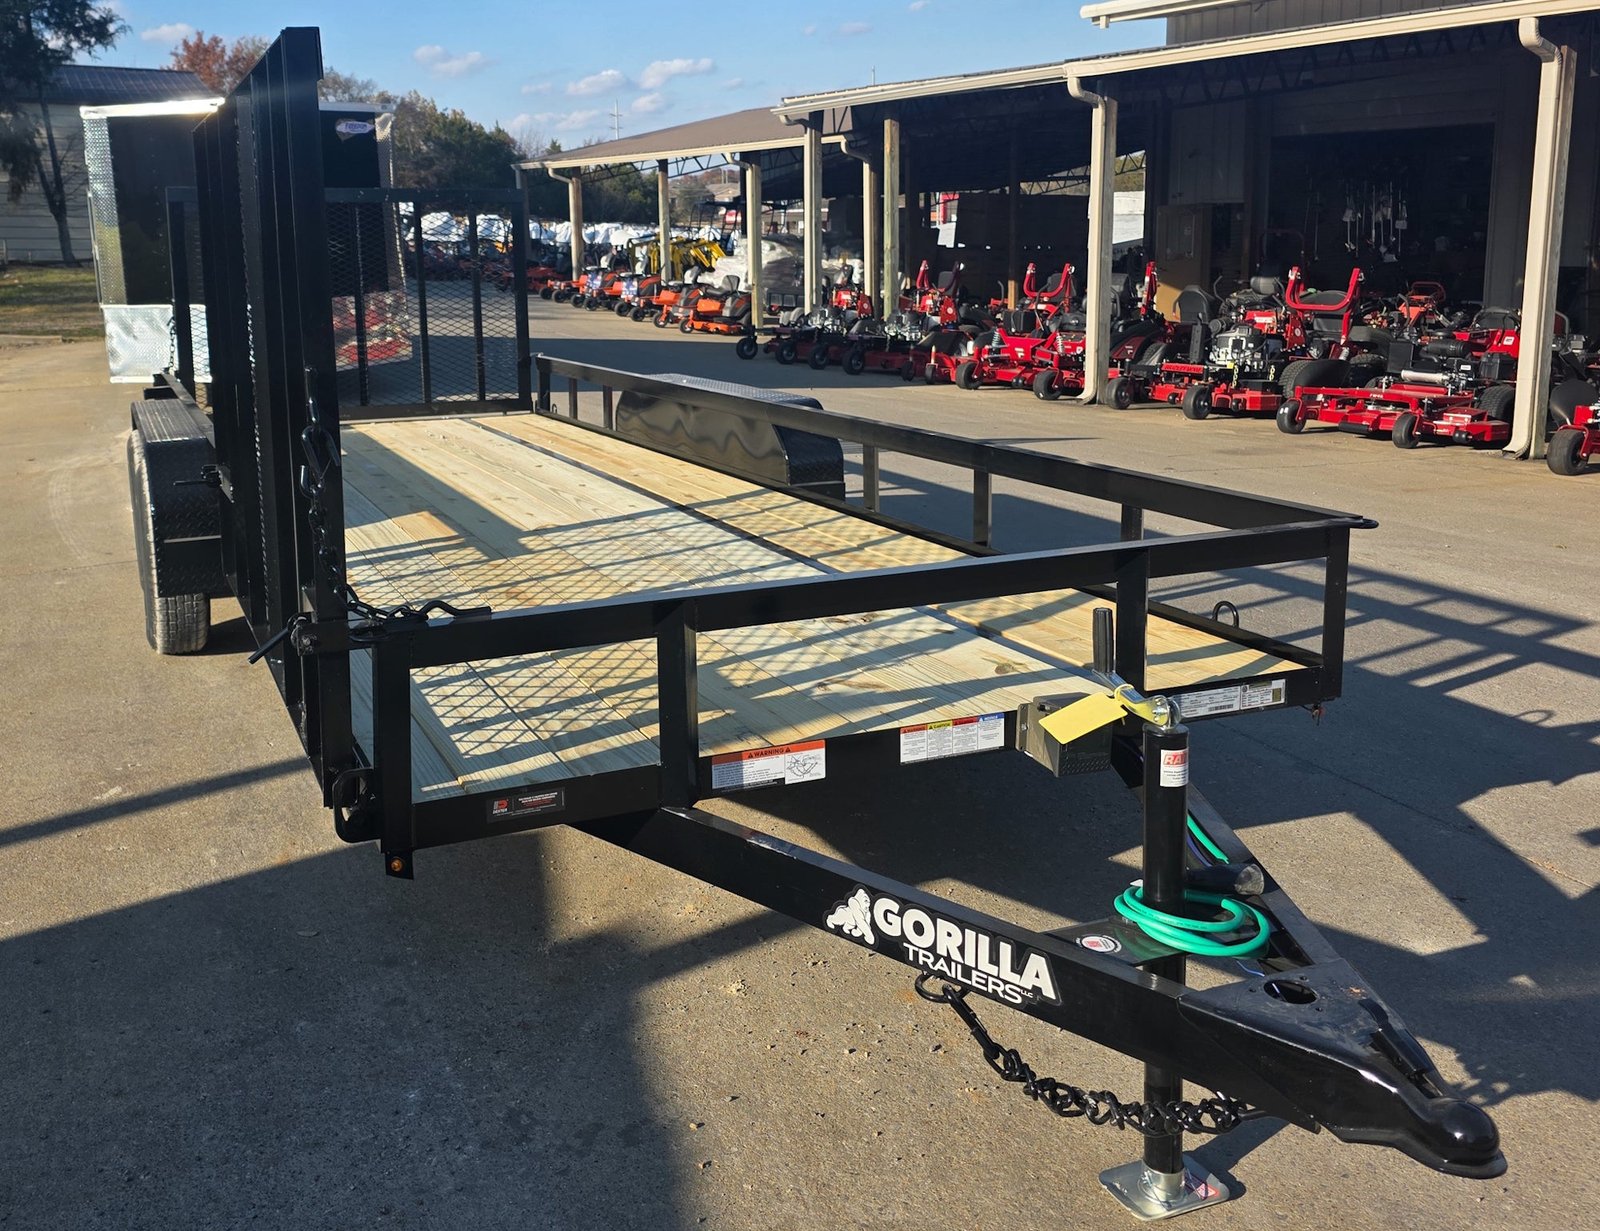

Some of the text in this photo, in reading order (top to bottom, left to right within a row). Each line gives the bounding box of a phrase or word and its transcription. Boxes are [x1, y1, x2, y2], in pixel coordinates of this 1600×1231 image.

[754, 748, 784, 757] WARNING
[873, 898, 1056, 999] GORILLA
[903, 943, 1022, 1004] TRAILERS
